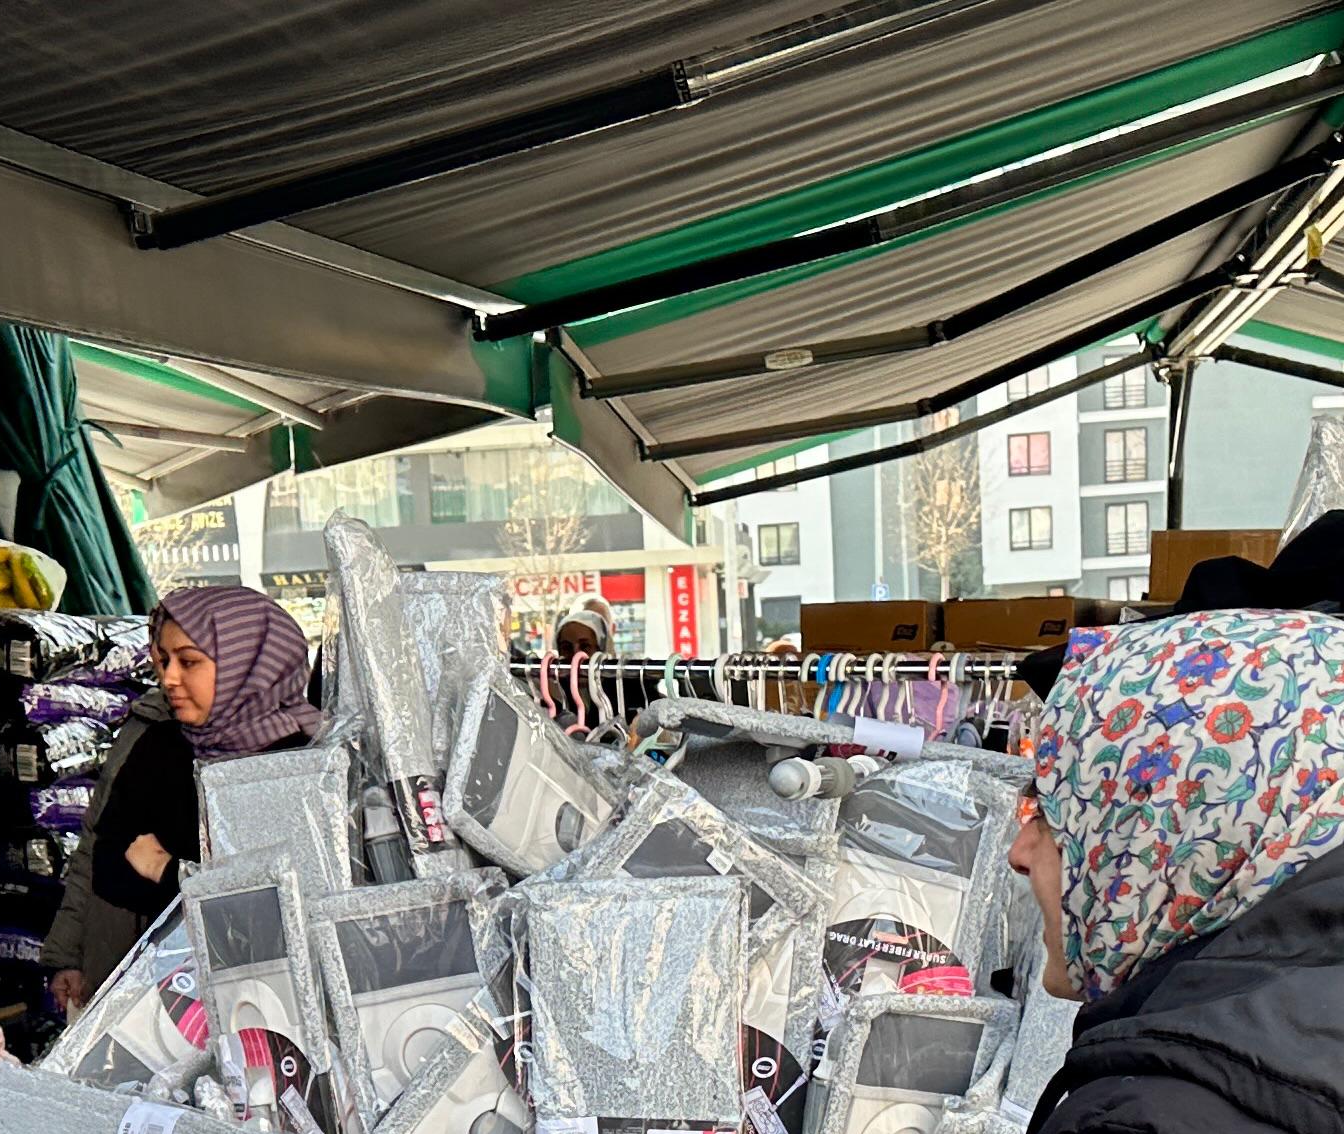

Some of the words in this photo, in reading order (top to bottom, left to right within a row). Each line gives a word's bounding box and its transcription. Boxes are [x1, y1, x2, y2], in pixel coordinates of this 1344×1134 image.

[514, 573, 596, 596] CZANE
[676, 575, 693, 657] ECZAN
[829, 930, 857, 945] DRAG
